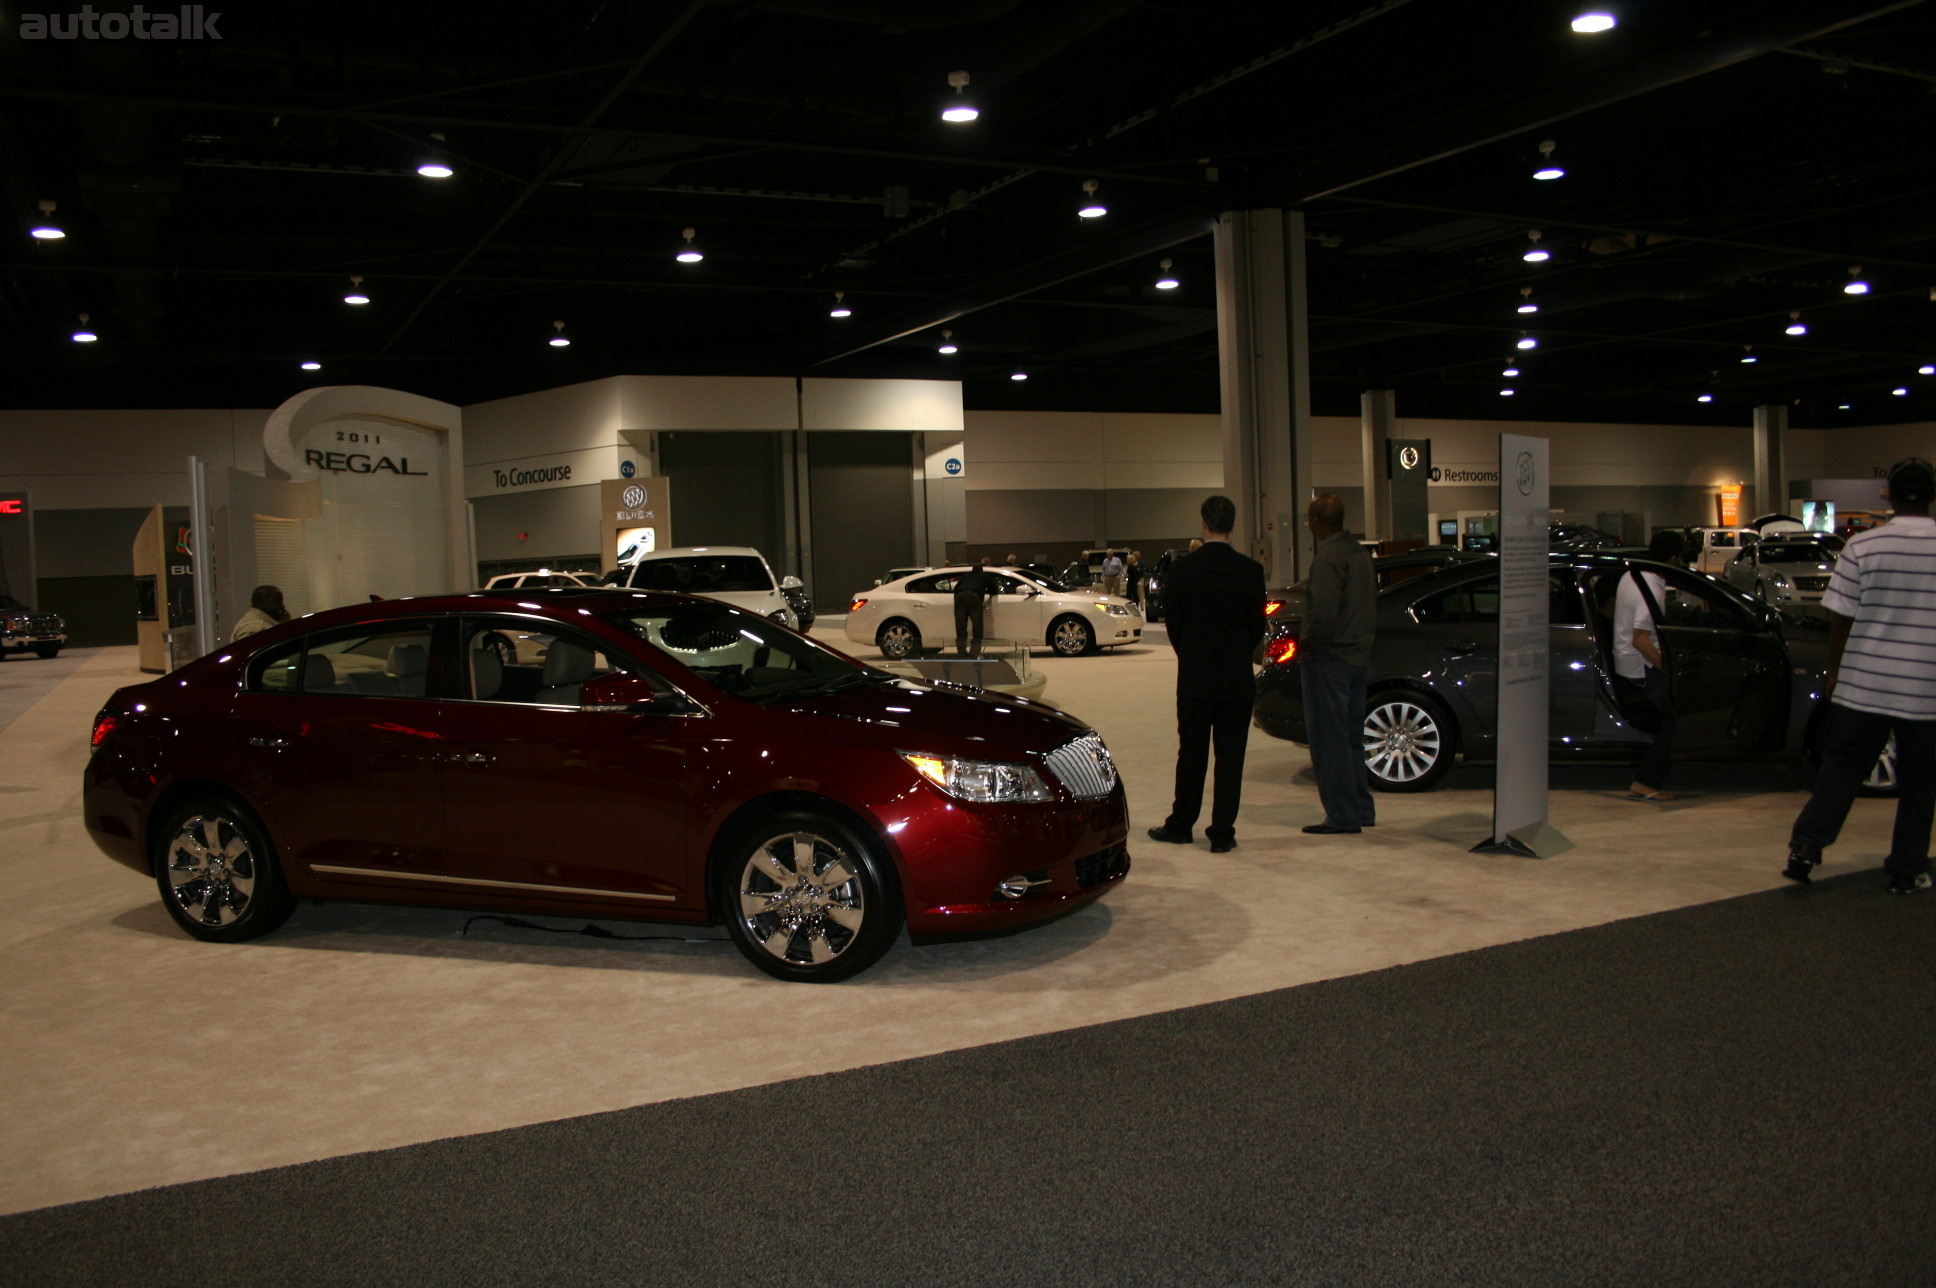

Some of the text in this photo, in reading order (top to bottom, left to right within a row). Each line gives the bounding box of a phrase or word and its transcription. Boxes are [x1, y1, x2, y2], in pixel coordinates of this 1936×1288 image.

[336, 431, 380, 444] 2011
[305, 448, 428, 476] REGAL
[493, 465, 571, 488] To Concourse
[1444, 469, 1499, 481] Restrooms
